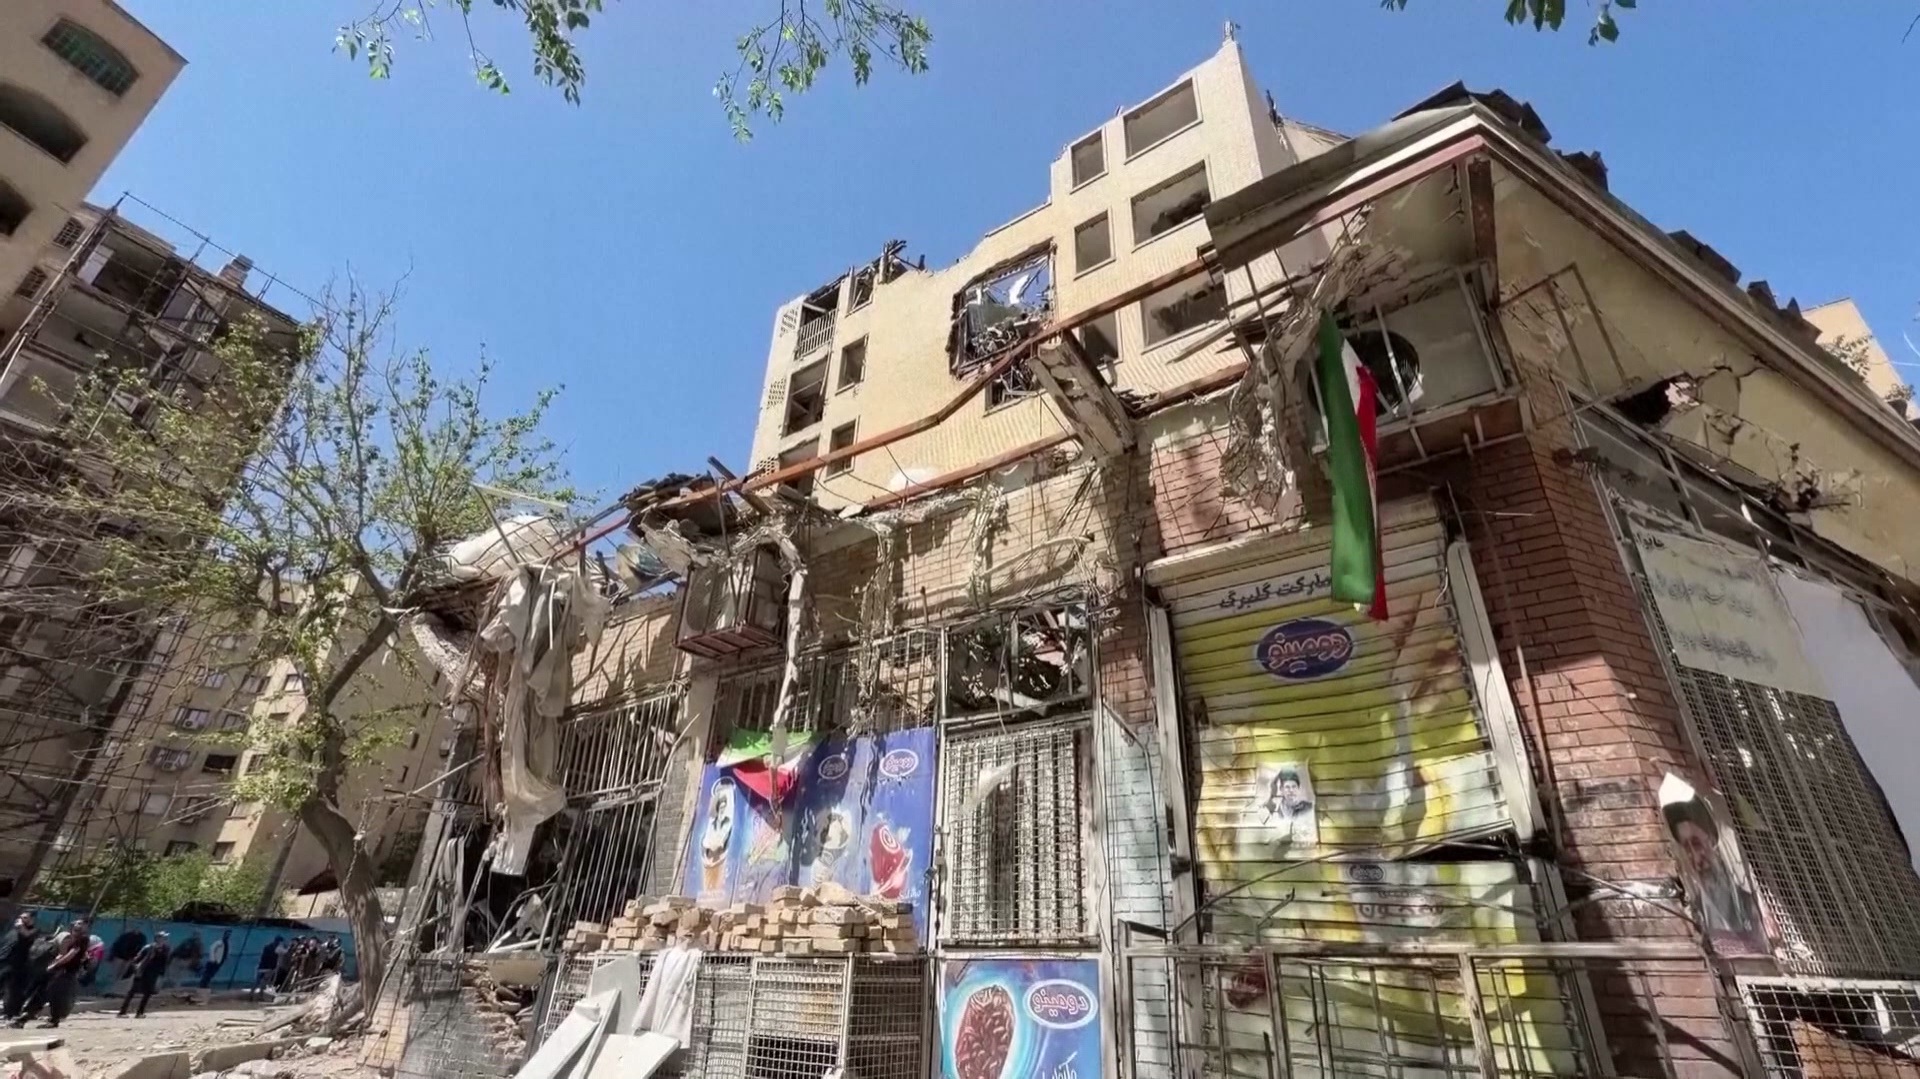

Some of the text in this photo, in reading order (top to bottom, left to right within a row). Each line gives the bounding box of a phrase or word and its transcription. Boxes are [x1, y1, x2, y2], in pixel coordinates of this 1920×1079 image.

[1218, 582, 1272, 610] گلبرگ
[1267, 632, 1350, 674] دومینو
[1032, 989, 1089, 1017] دومینو
